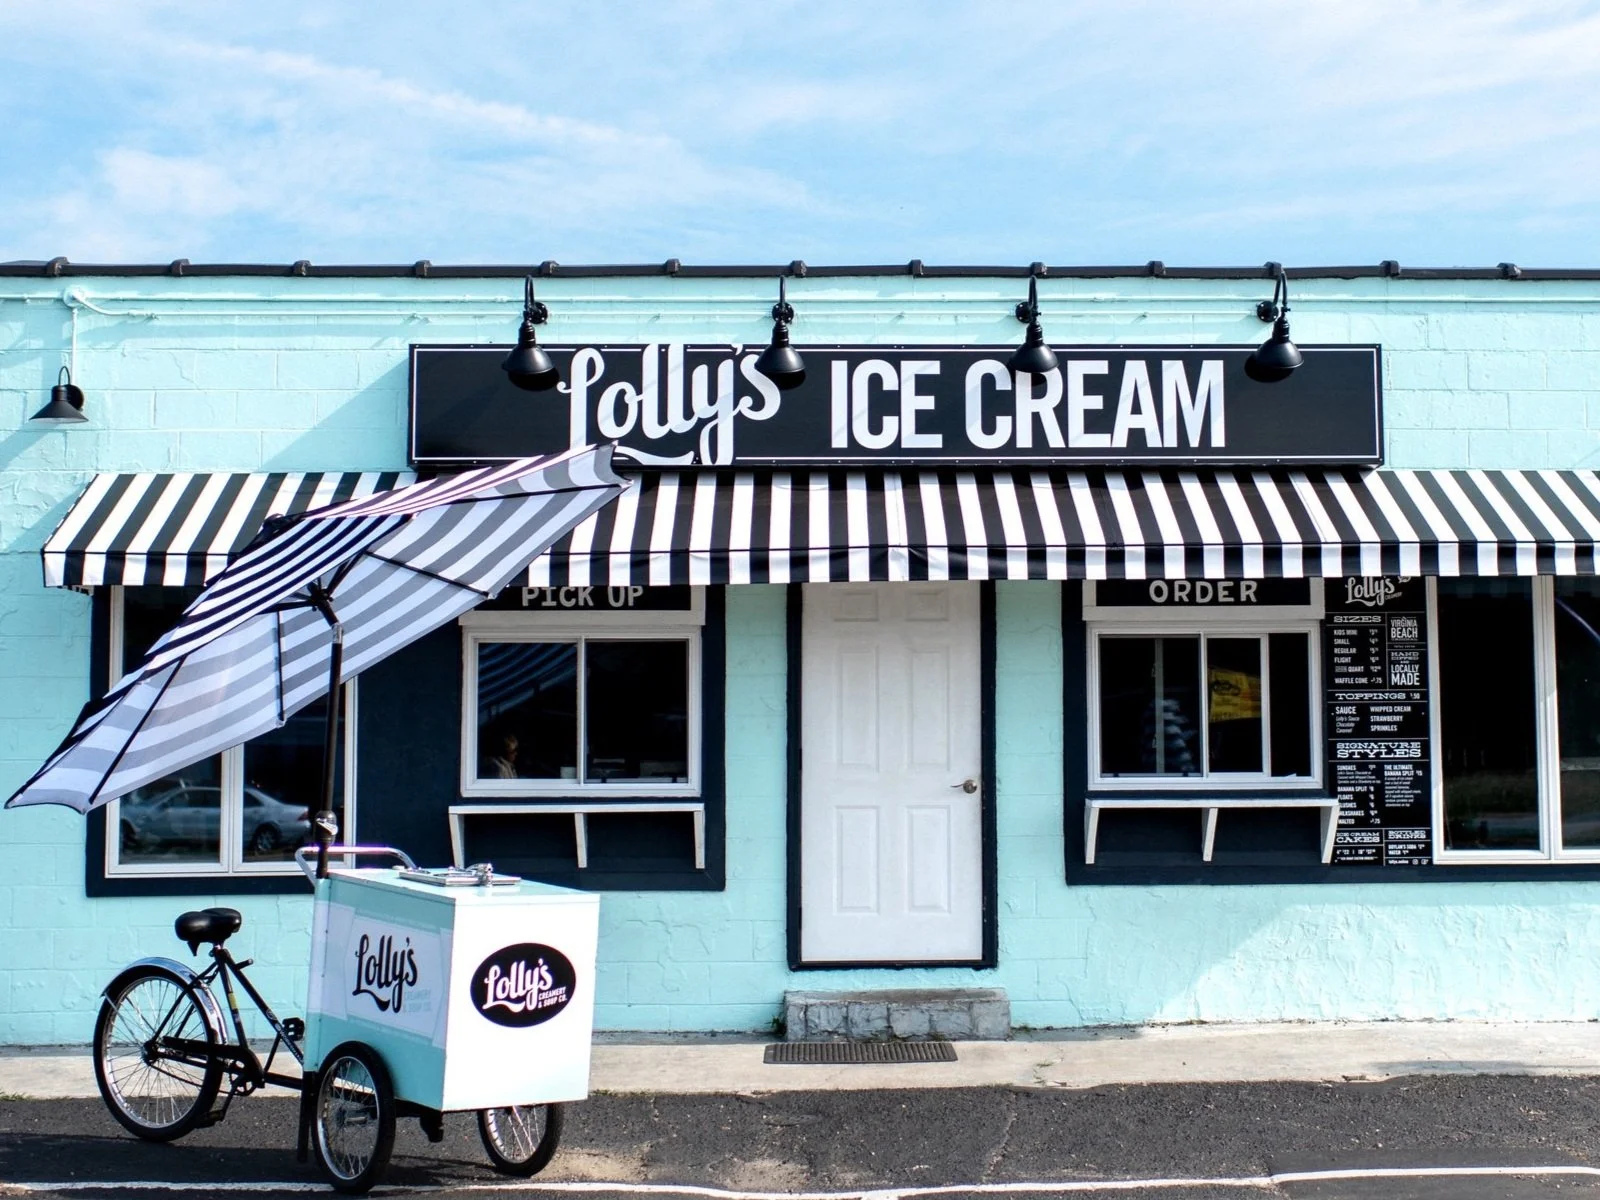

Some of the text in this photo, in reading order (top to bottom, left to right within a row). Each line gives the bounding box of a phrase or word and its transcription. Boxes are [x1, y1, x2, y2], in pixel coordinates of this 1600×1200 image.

[556, 344, 1226, 467] Lolly's ICE CREAM
[521, 585, 644, 607] PICK UP
[1148, 579, 1258, 603] ORDER
[1345, 576, 1395, 607] Lolly's
[1333, 615, 1382, 623] SIZES
[1391, 617, 1418, 628] VIRGINIA
[1390, 627, 1418, 639] BEACH
[1347, 665, 1364, 673] QUART
[1390, 664, 1420, 673] LOCALLY
[1391, 672, 1421, 686] MADE
[1335, 692, 1406, 700] TOPPINGS
[1335, 706, 1357, 714] SAUCE
[1370, 705, 1393, 713] WHIPPED
[1370, 724, 1398, 732] SPRINKLES
[1336, 741, 1421, 749] SIGNATURE
[1336, 749, 1422, 759] STYLES
[352, 934, 418, 1014] Lolly's
[482, 958, 553, 1013] Lolly's
[538, 986, 567, 1001] CREAMERY
[543, 999, 558, 1008] SOUP
[559, 995, 568, 1004] CO.
